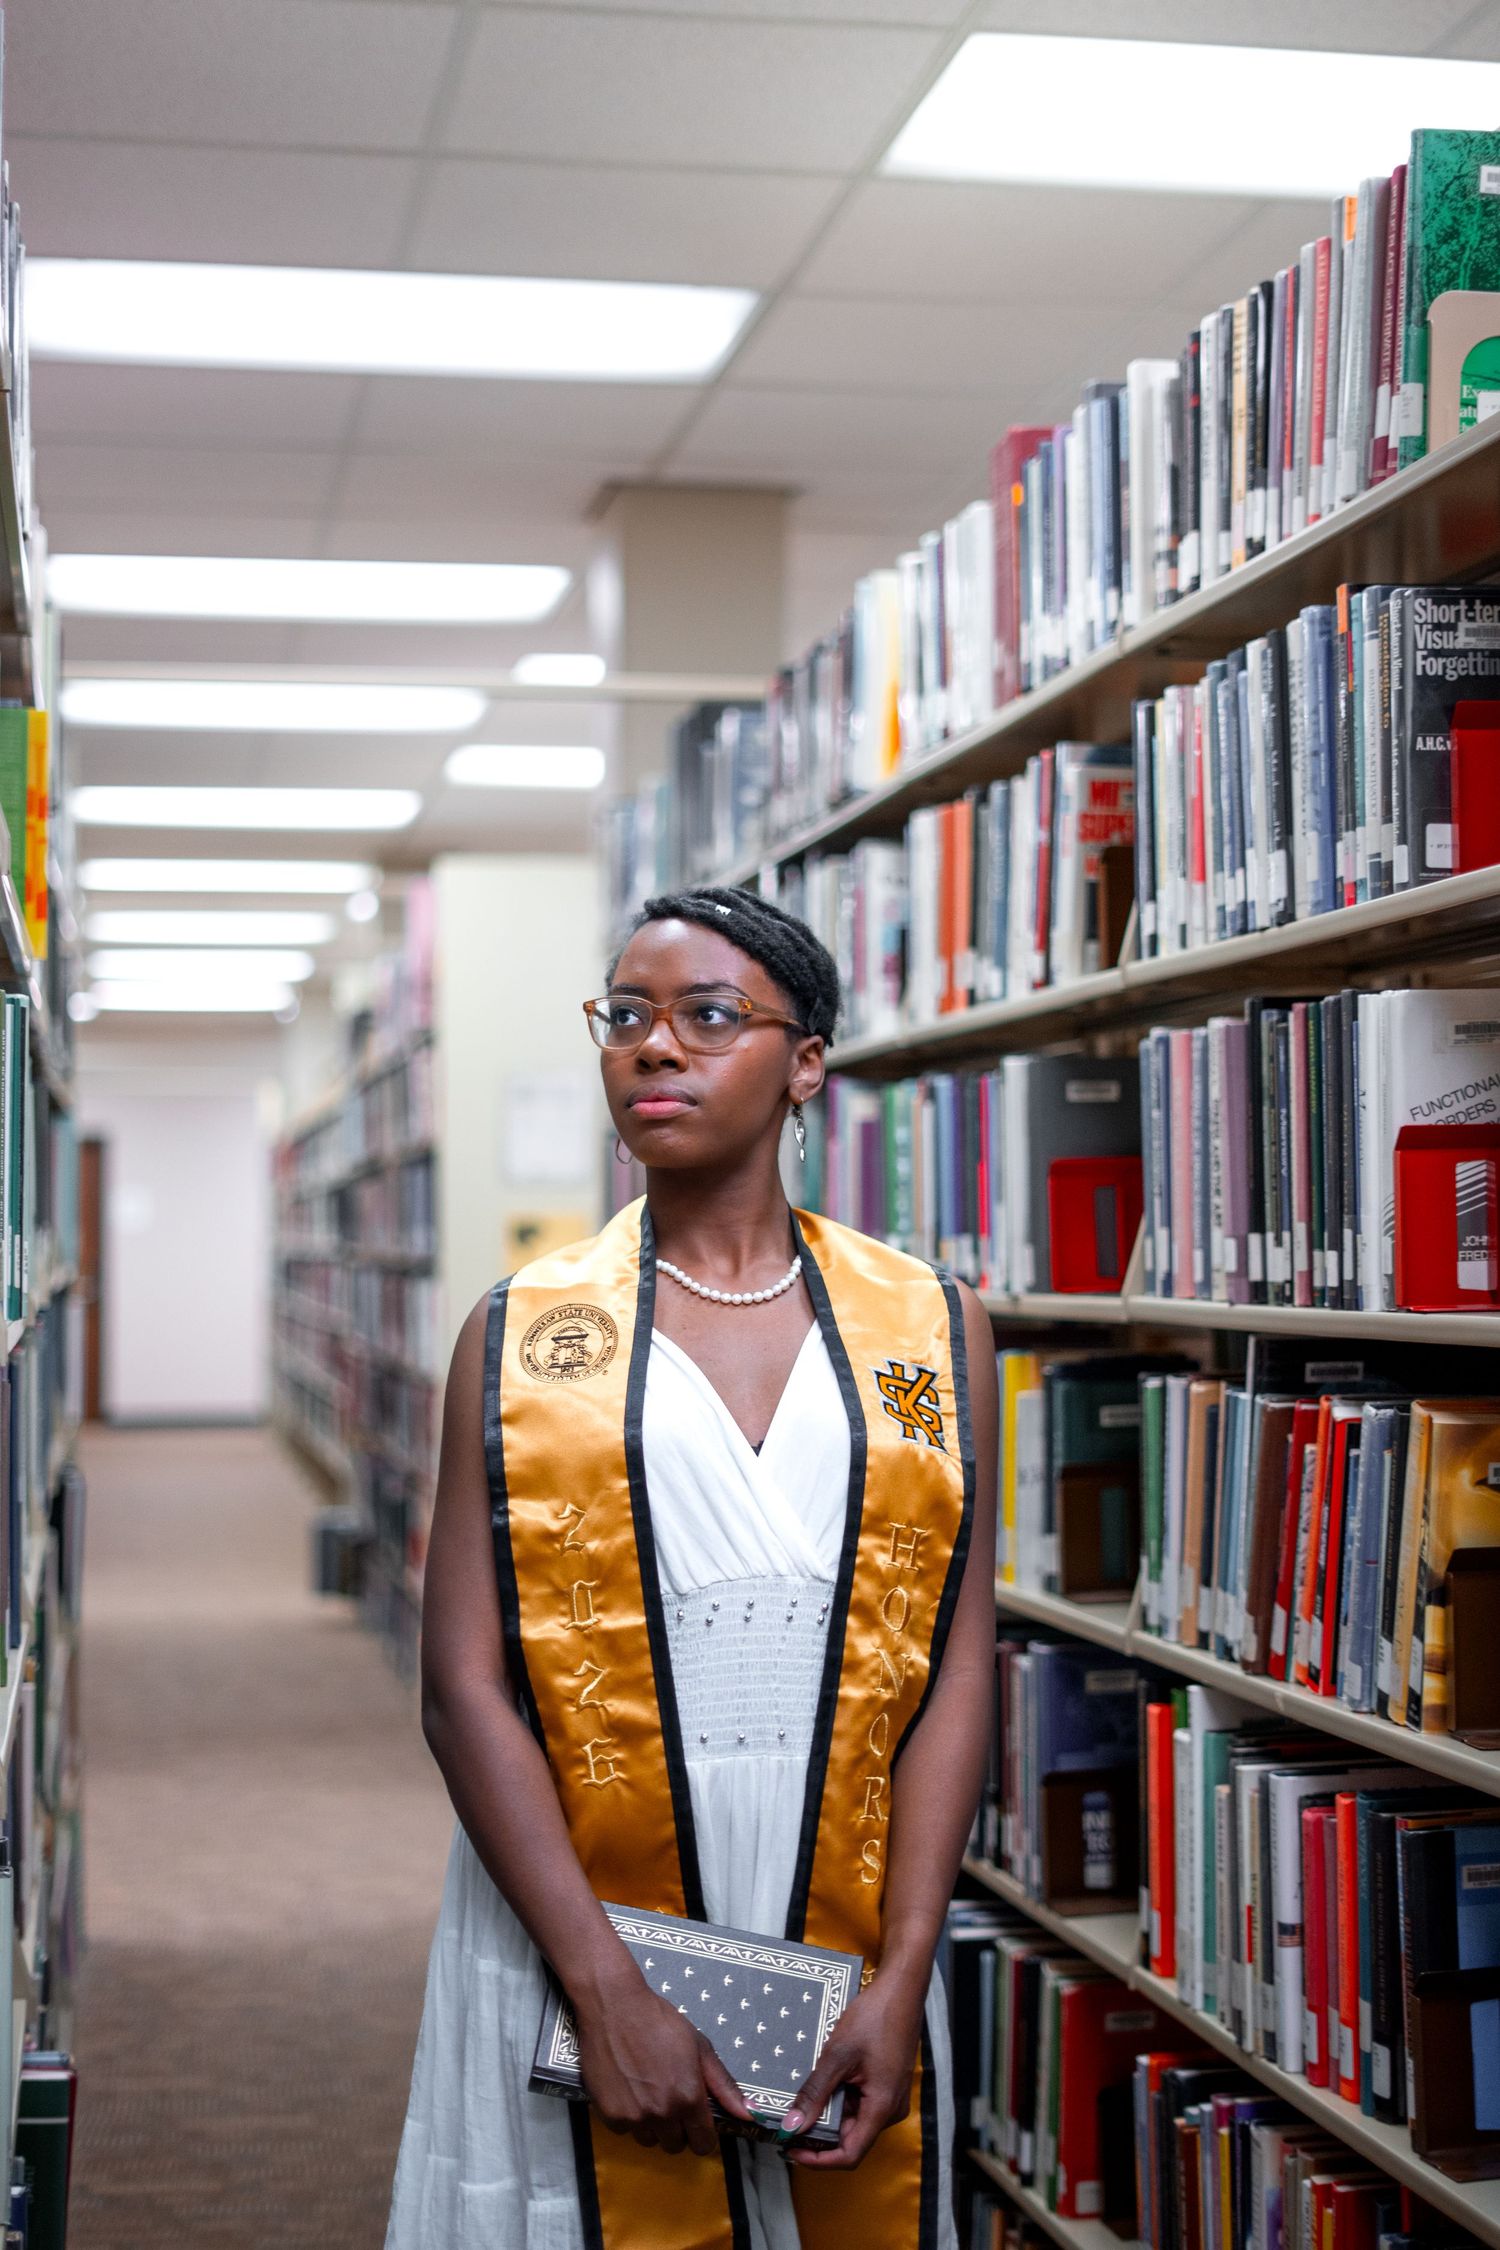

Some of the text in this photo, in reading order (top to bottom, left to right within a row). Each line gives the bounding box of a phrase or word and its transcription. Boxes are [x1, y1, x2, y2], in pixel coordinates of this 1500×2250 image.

[1413, 597, 1500, 623] Short-ter
[1414, 624, 1462, 650] Visua
[1416, 650, 1500, 681] Forgettin
[1459, 1250, 1488, 1261] FRED
[527, 1309, 613, 1347] KENNESAW STATE UNIVERSITY
[526, 1353, 551, 1379] UNIVERSITY
[551, 1373, 580, 1381] SYSTEM
[592, 1345, 612, 1371] GEORGIA
[557, 1502, 622, 1790] 2026
[860, 1521, 926, 1885] HONORS
